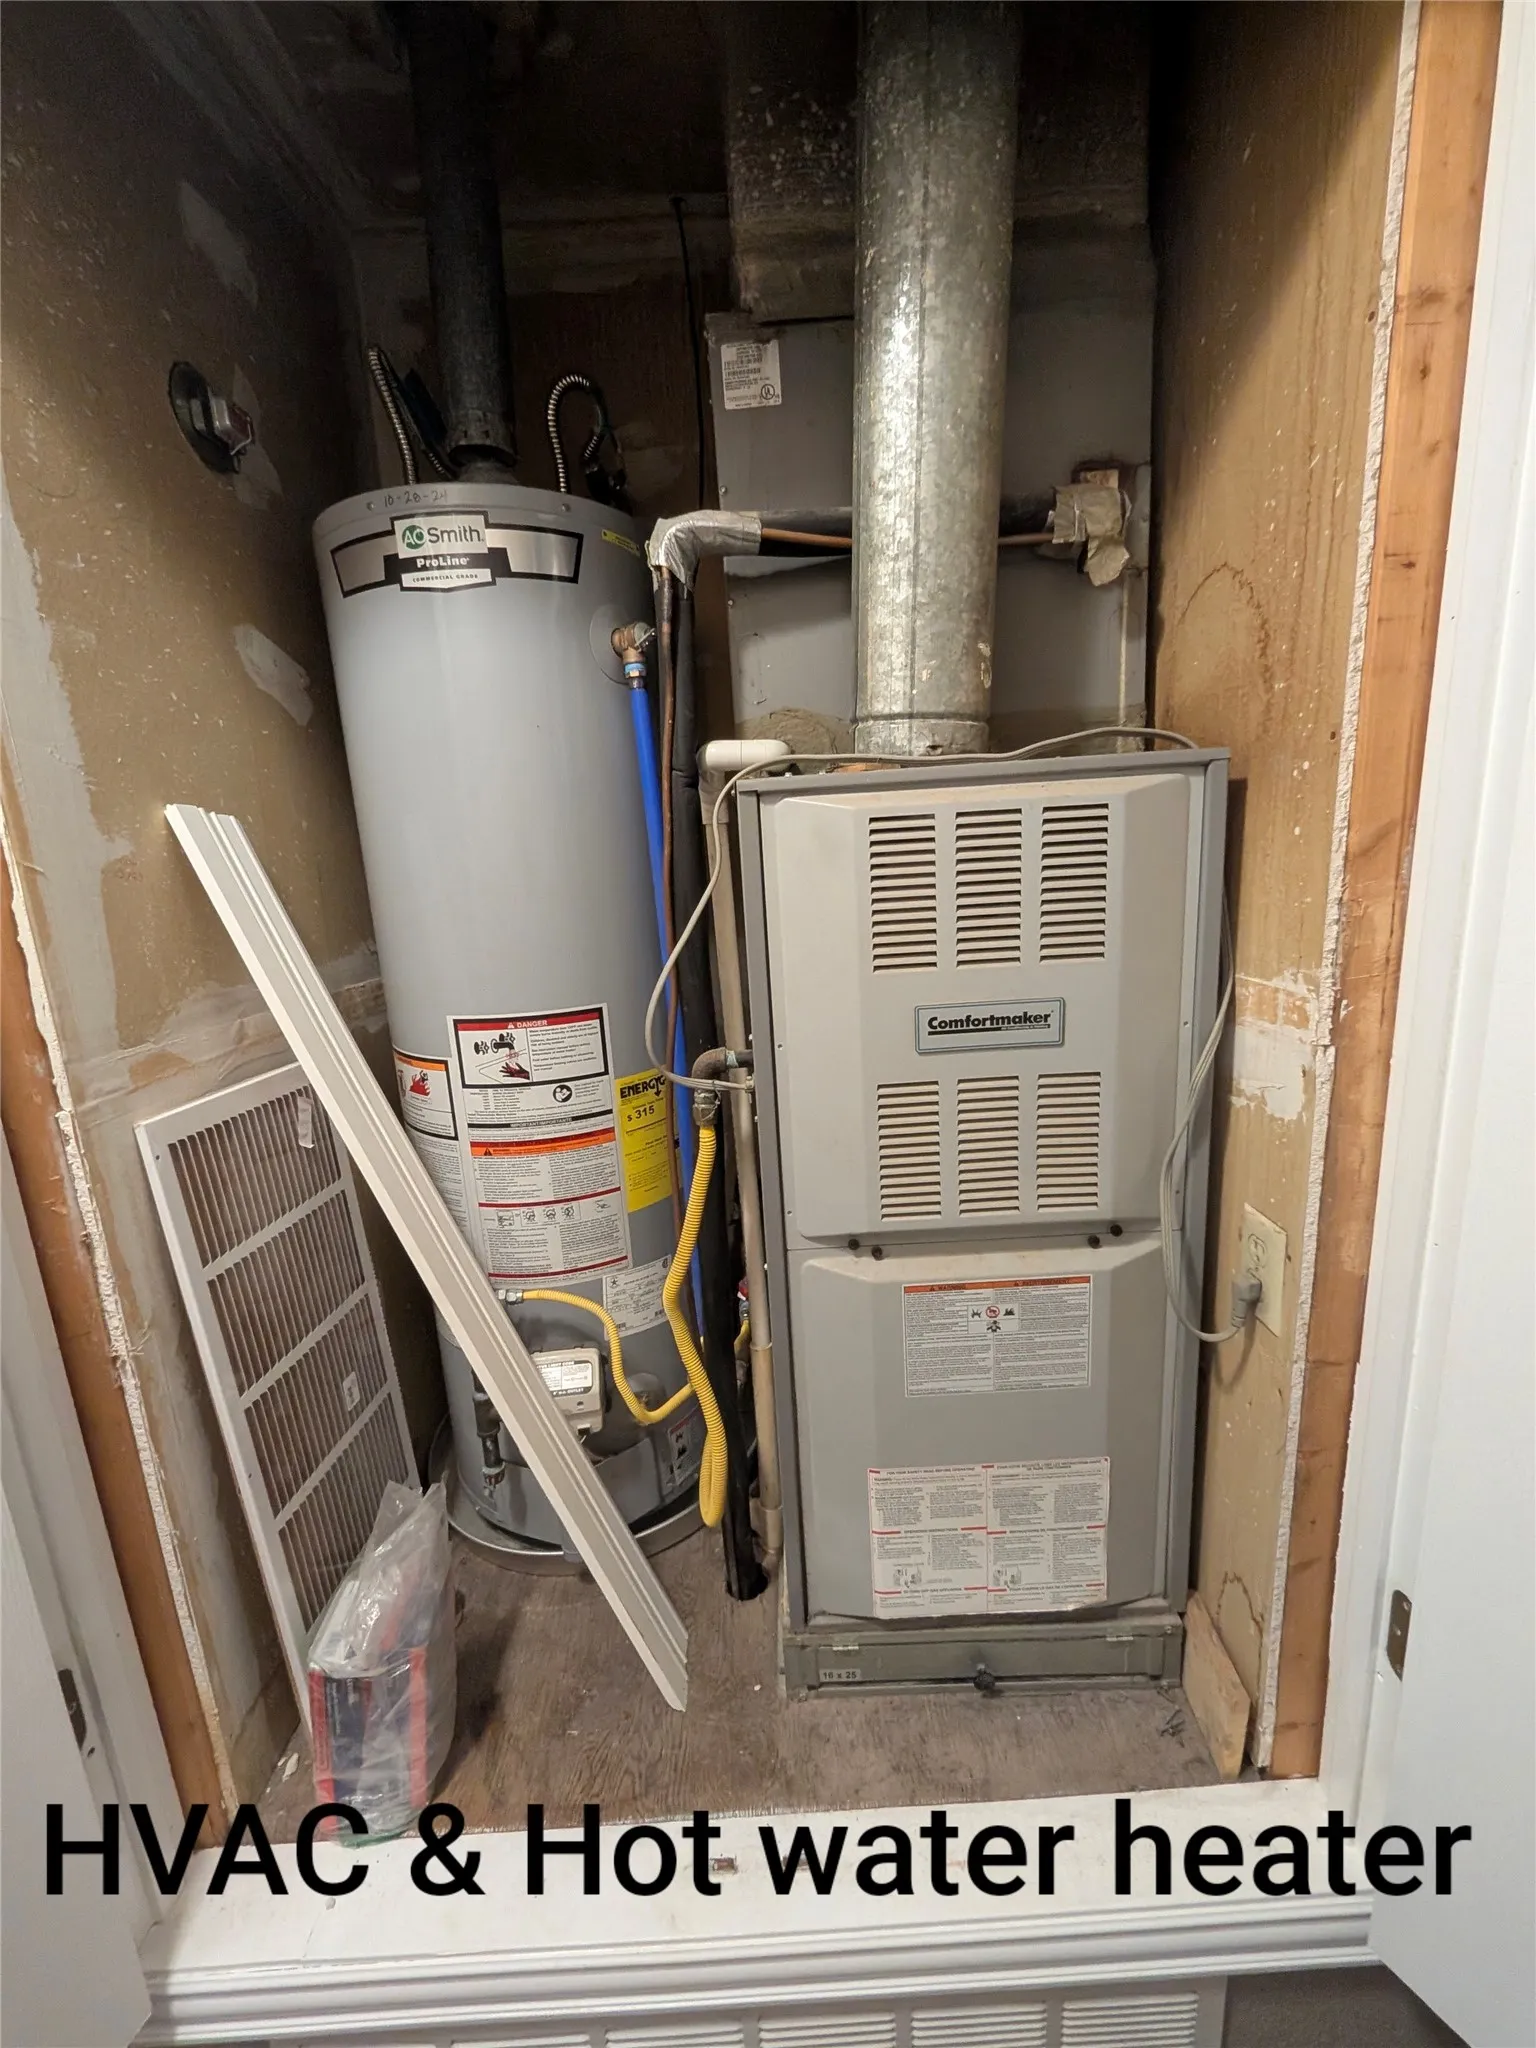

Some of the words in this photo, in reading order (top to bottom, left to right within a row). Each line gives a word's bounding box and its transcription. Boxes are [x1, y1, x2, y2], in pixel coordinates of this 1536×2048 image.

[416, 556, 467, 568] ProLine
[516, 1019, 548, 1029] DANGER
[927, 1011, 1051, 1030] Comfortmaker
[620, 1075, 665, 1099] ENERGYG
[635, 1105, 655, 1120] 315
[823, 1671, 834, 1680] 16
[846, 1671, 857, 1680] 25
